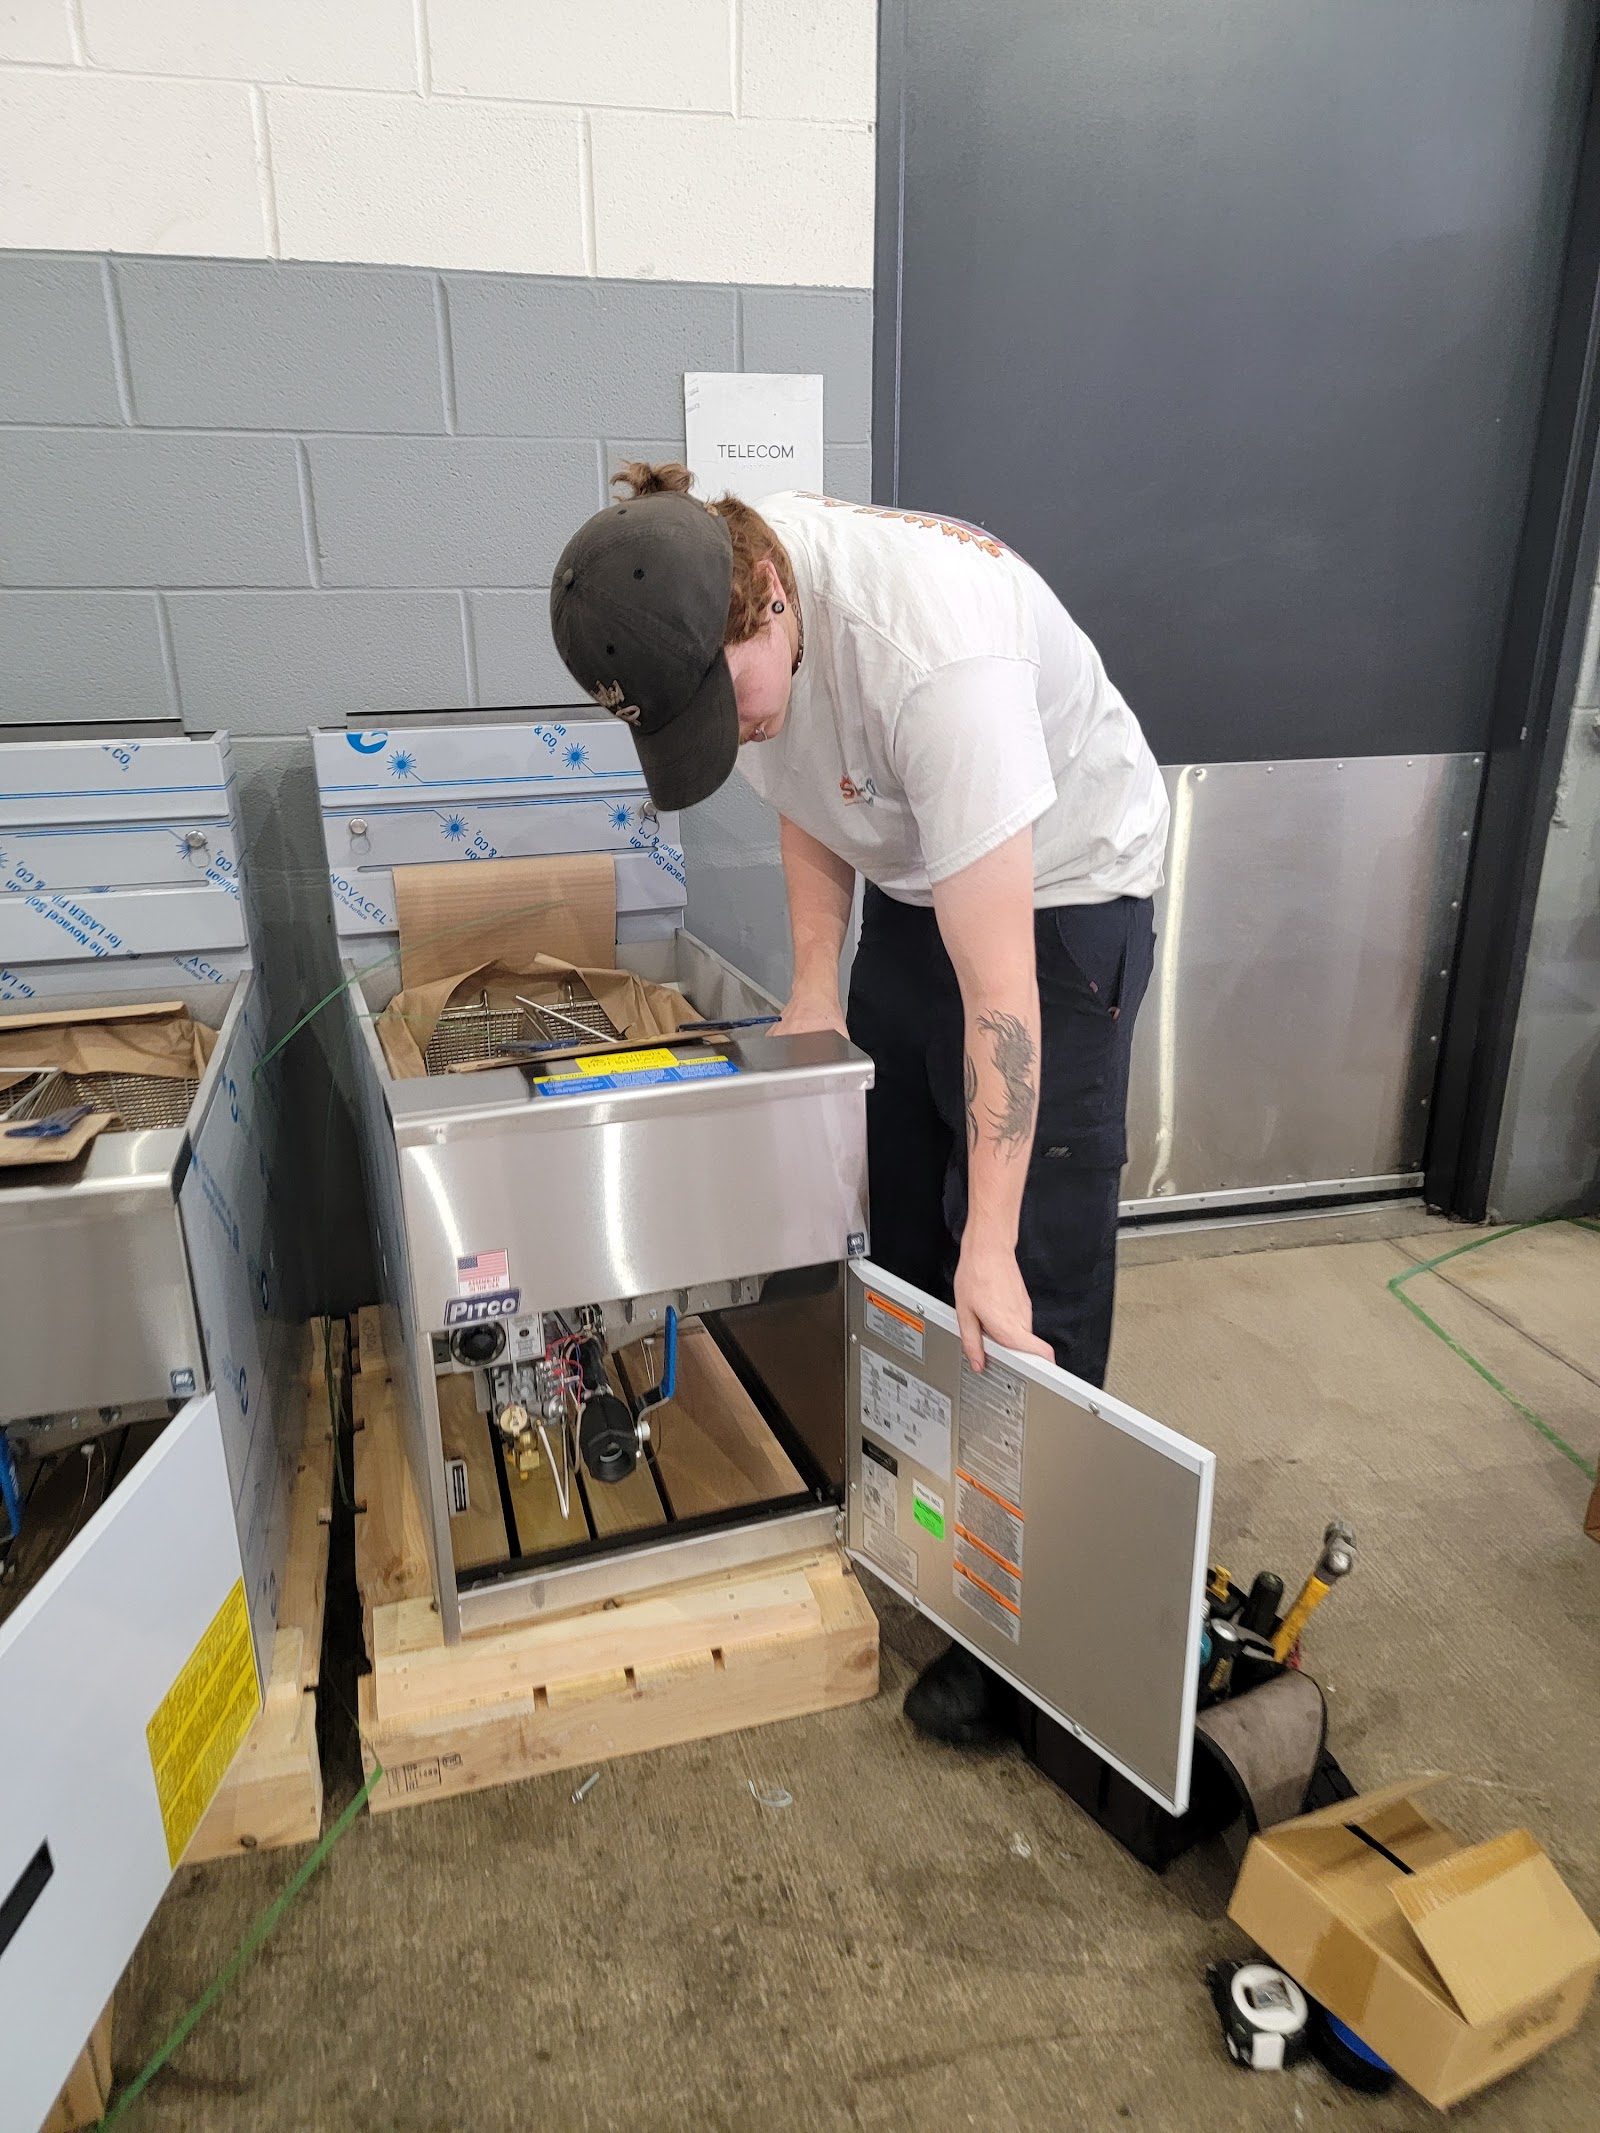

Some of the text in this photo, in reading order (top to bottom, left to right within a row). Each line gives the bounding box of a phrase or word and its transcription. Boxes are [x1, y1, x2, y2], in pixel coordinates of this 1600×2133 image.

[717, 444, 794, 459] TELECOM
[329, 873, 387, 925] NOVACEL
[44, 908, 91, 946] Novacel
[68, 904, 107, 936] LASER
[104, 931, 123, 949] for
[449, 1298, 516, 1322] PITCO
